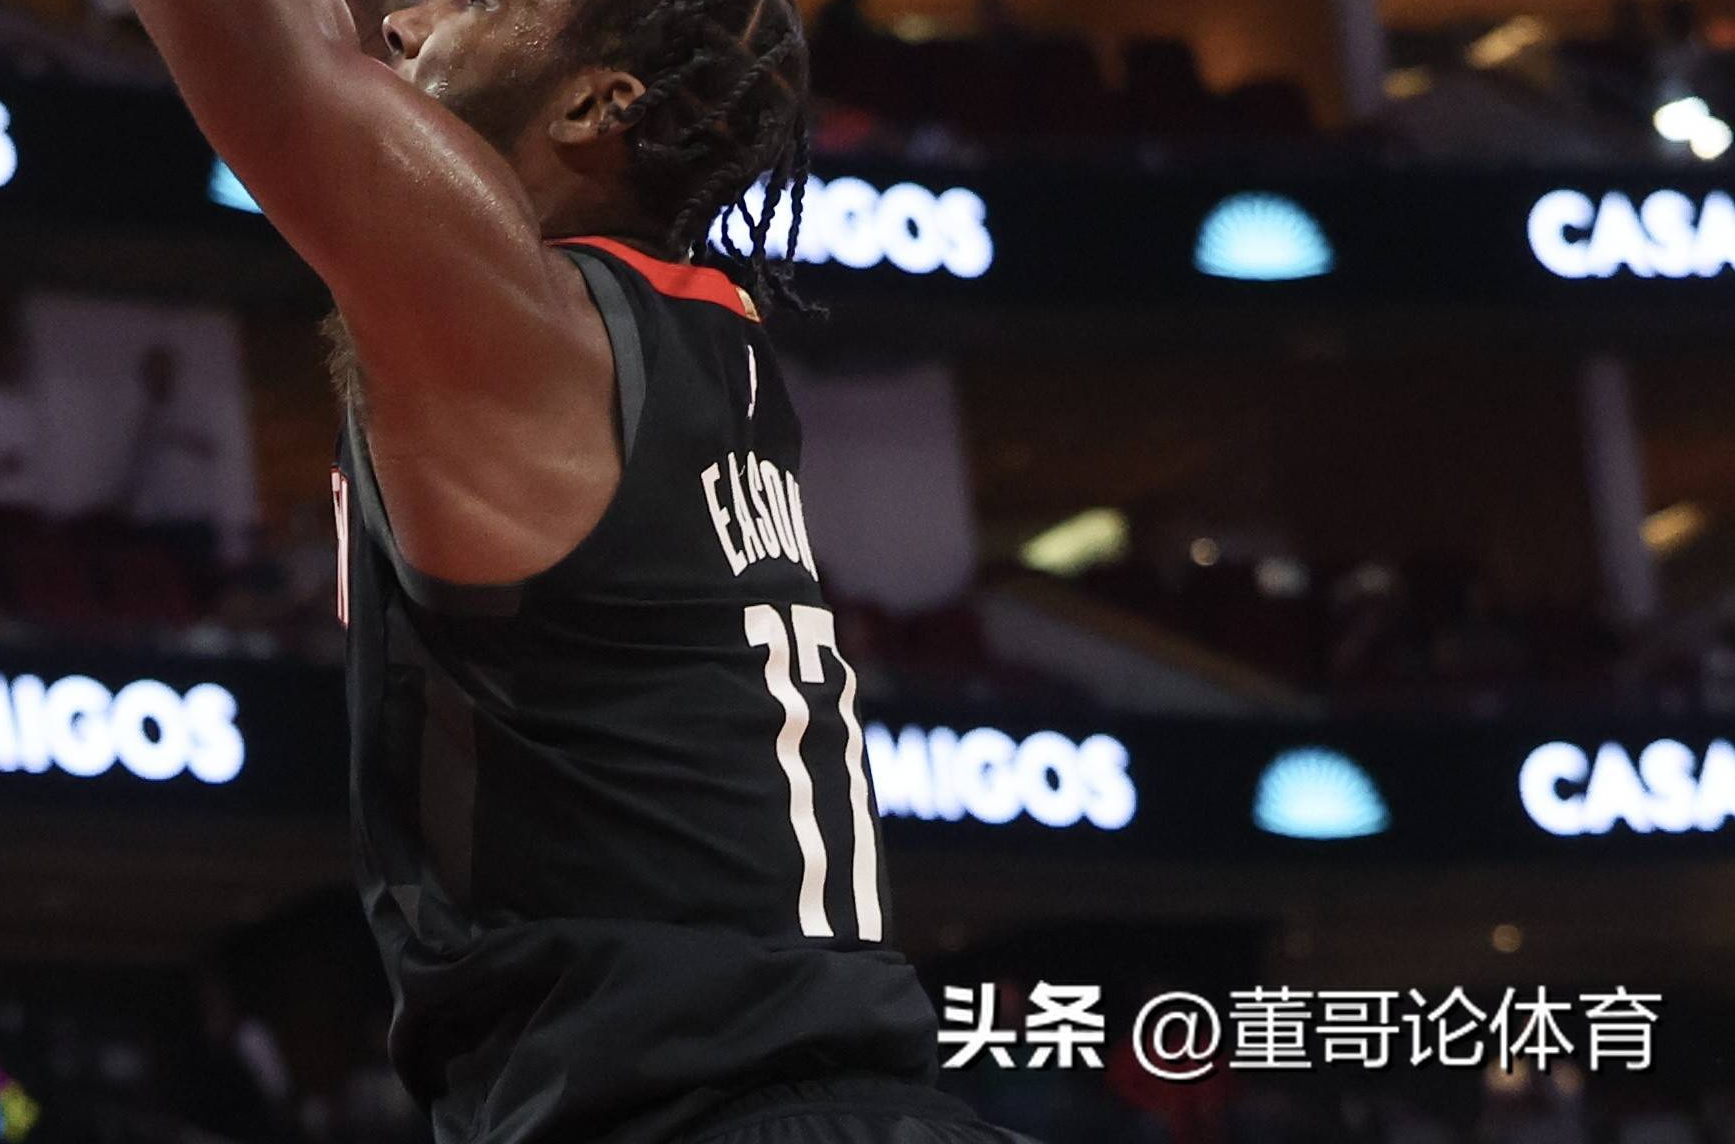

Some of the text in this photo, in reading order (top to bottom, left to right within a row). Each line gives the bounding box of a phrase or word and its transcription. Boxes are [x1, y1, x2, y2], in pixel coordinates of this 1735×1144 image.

[706, 169, 993, 278] MIGOS
[701, 451, 819, 581] EASON
[744, 604, 883, 942] 17
